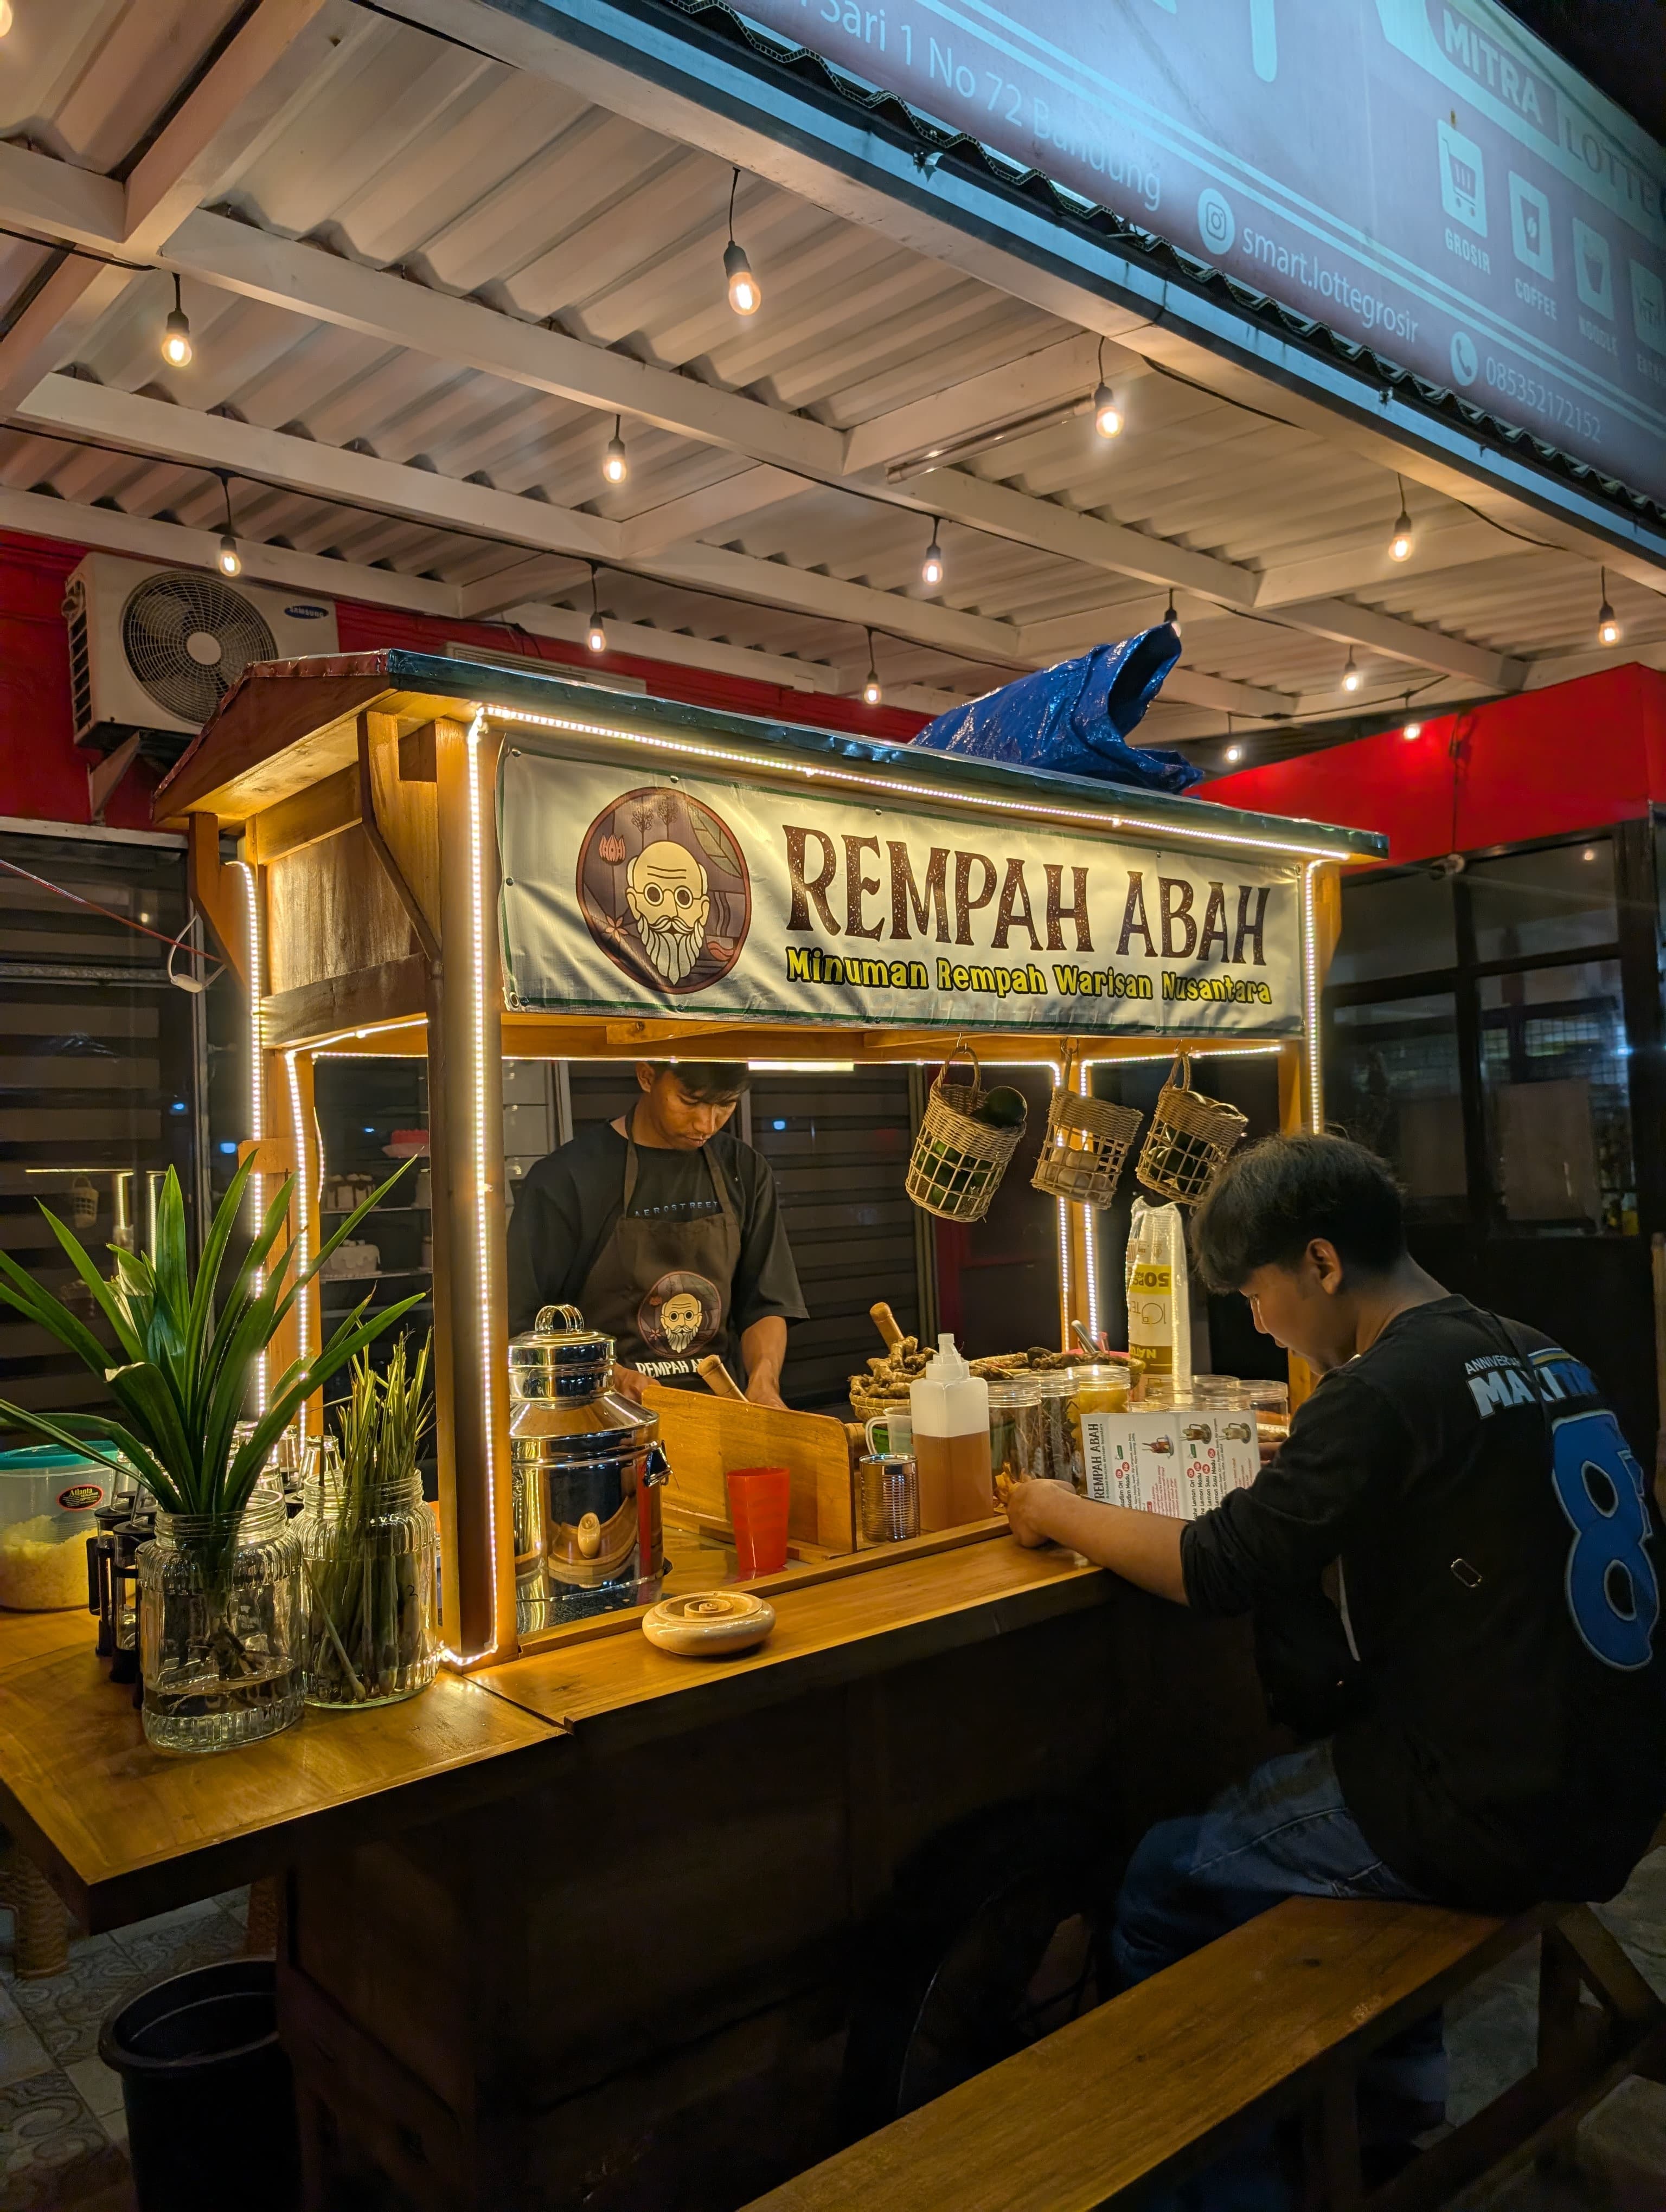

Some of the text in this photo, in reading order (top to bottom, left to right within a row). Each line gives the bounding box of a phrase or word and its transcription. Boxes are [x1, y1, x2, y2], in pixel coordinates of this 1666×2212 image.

[901, 25, 912, 66] 1
[930, 37, 975, 98] No
[986, 72, 1022, 127] 72
[1443, 8, 1543, 125] MITRA
[1445, 228, 1491, 275] GROSIR
[1242, 227, 1419, 343] smart.lottegrosir
[1515, 277, 1558, 321] COFFEE
[782, 824, 1270, 966] REMPAH ABAH
[786, 947, 1272, 1004] Minuman Rempah Warisan Nusantara
[635, 1201, 718, 1217] AEROSTREET
[1144, 1271, 1170, 1287] 50
[635, 1360, 689, 1378] REMPAH
[1087, 1423, 1105, 1499] REMPAH ABAH
[70, 1488, 93, 1496] Atlanta
